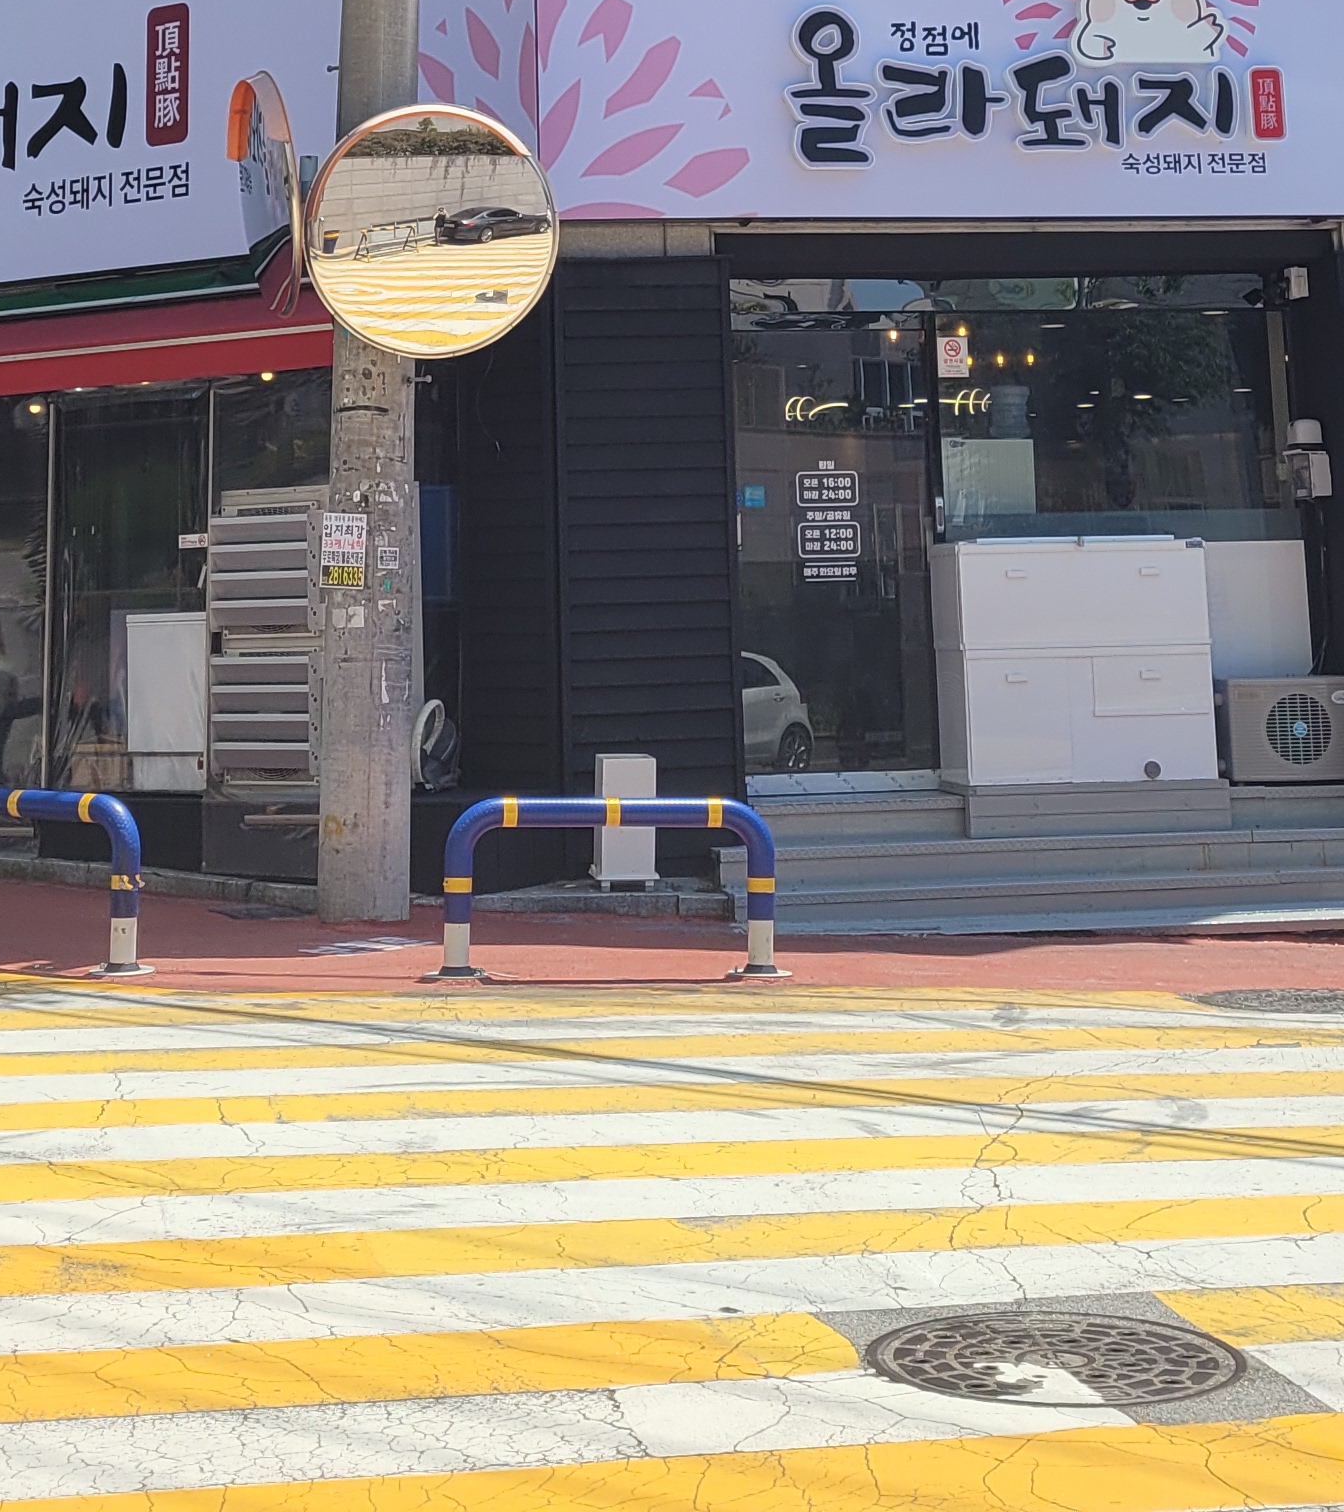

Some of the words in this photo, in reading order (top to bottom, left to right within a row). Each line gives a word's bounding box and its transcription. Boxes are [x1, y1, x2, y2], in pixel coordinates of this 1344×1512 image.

[889, 21, 981, 56] 정점에
[153, 19, 182, 129] 頂點豚
[787, 7, 1240, 166] 올라돼지
[1120, 151, 1203, 176] 숙성돼지
[1206, 151, 1268, 175] 전문점
[22, 173, 115, 216] 숙성돼지
[118, 161, 191, 206] 전문점
[803, 478, 819, 488] 오픈
[821, 477, 852, 488] 16:00
[803, 490, 819, 500] 마감
[821, 489, 852, 500] 24:00
[323, 523, 365, 539] 입지최강
[804, 529, 821, 539] 오픈
[823, 528, 853, 539] 12:00
[805, 541, 821, 551] 마감
[823, 541, 854, 551] 24:00
[819, 566, 842, 577] 화요일
[842, 566, 857, 577] 휴무
